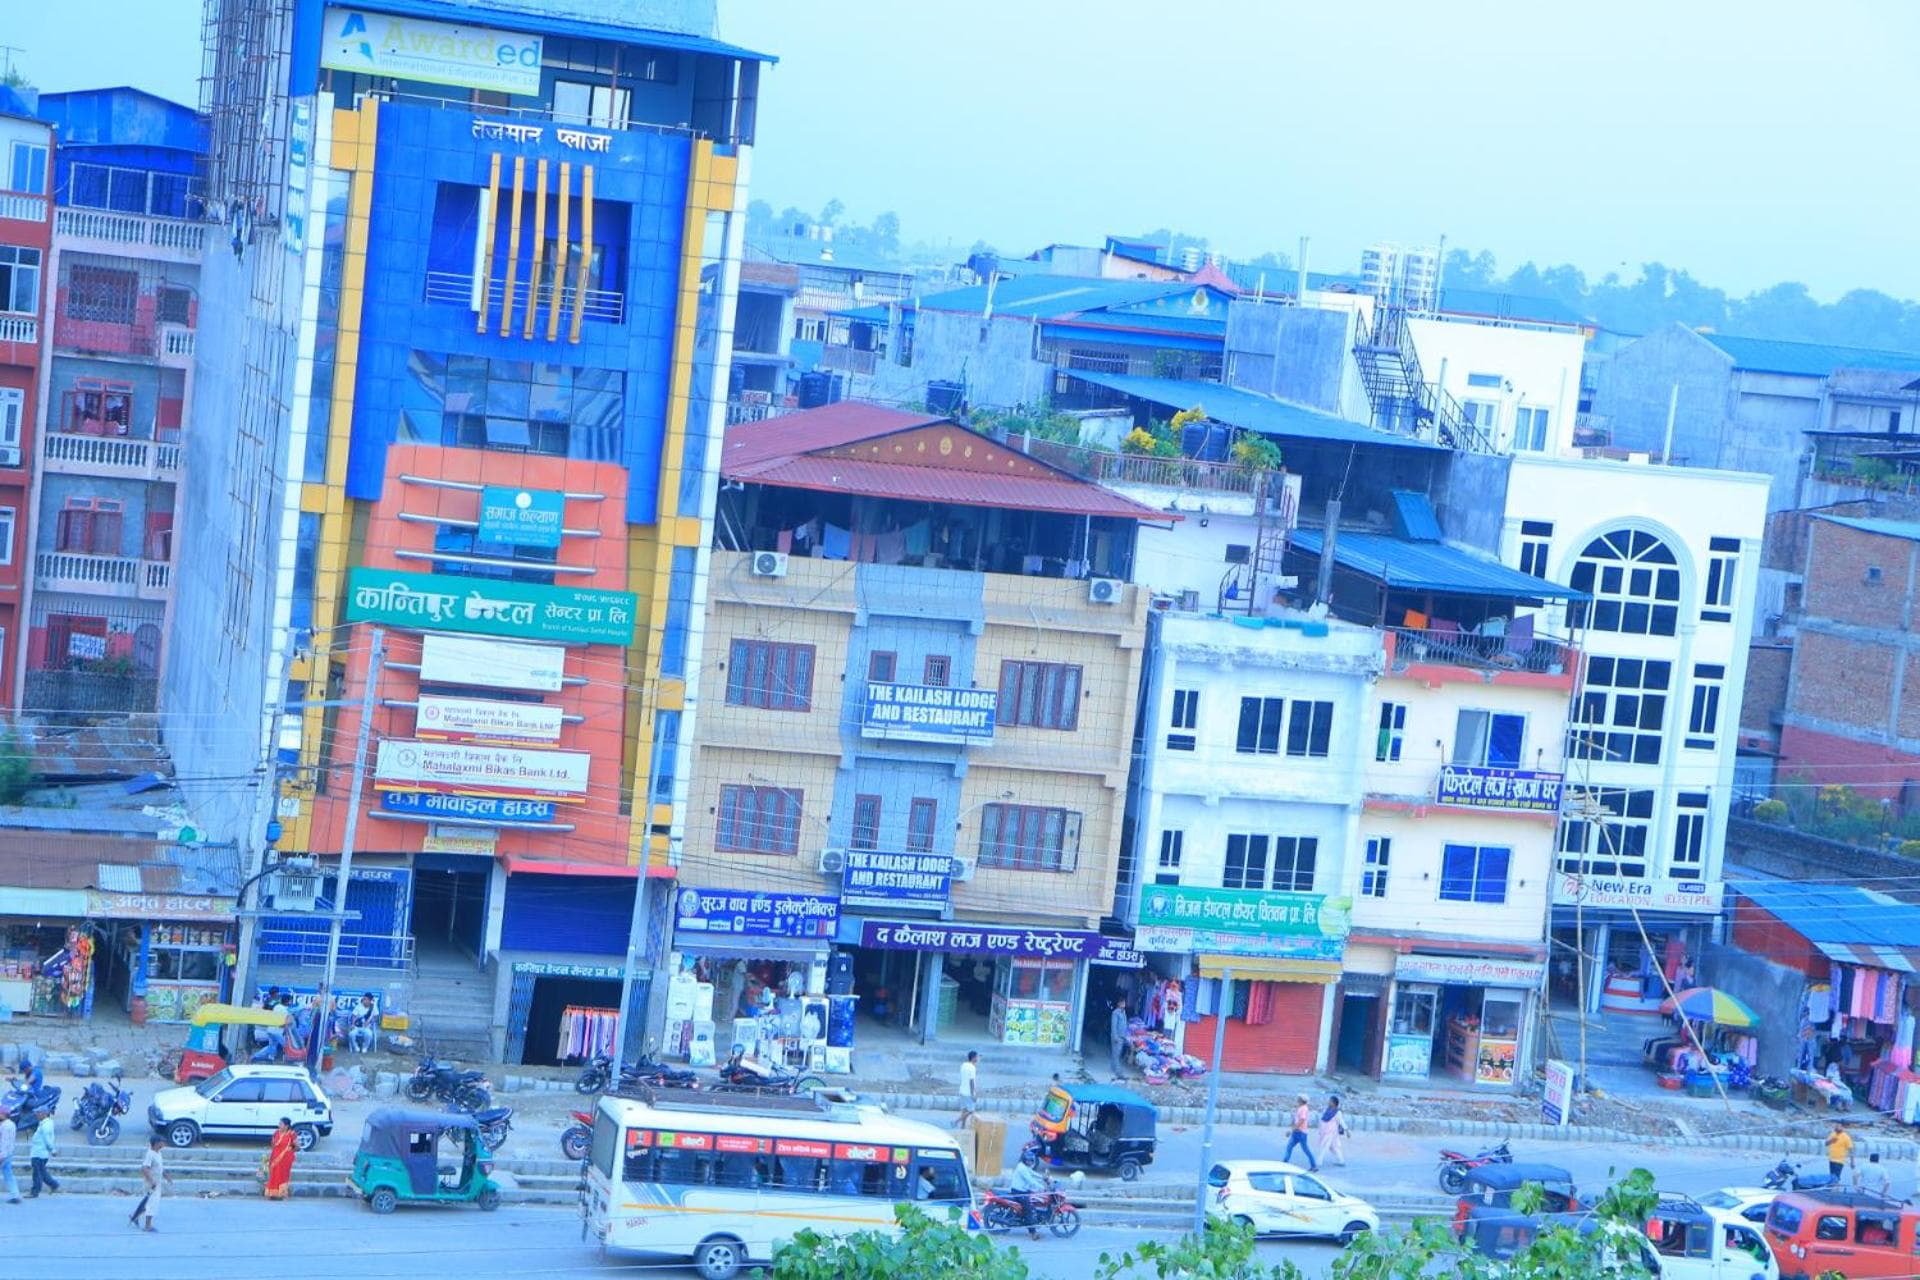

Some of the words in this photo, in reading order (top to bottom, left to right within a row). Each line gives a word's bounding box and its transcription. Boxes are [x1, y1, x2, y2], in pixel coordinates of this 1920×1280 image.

[381, 20, 540, 67] Awarded
[556, 128, 613, 152] प्लाजा
[356, 581, 459, 621] कान्तिपुर
[544, 601, 584, 620] सेन्टर
[868, 684, 894, 701] THE
[895, 686, 953, 706] KAILASH
[954, 691, 996, 710] LODGE
[872, 703, 901, 721] AND
[902, 706, 989, 728] RESTAURANT
[422, 759, 482, 774] Mahalaxmi
[485, 764, 516, 775] Bikas
[519, 766, 547, 777] Bank
[548, 768, 571, 780] Ltd.
[502, 799, 549, 817] हाउस
[848, 853, 868, 868] THE
[869, 854, 917, 872] KAILASH
[917, 857, 952, 873] LODGE
[850, 870, 874, 886] AND
[875, 871, 945, 890] RESTAURANT
[1591, 879, 1624, 894] New
[1628, 881, 1653, 896] Era
[876, 928, 890, 944] द
[894, 924, 948, 947] कैलाश
[950, 932, 984, 948] लज
[987, 933, 1021, 950] एण्ड
